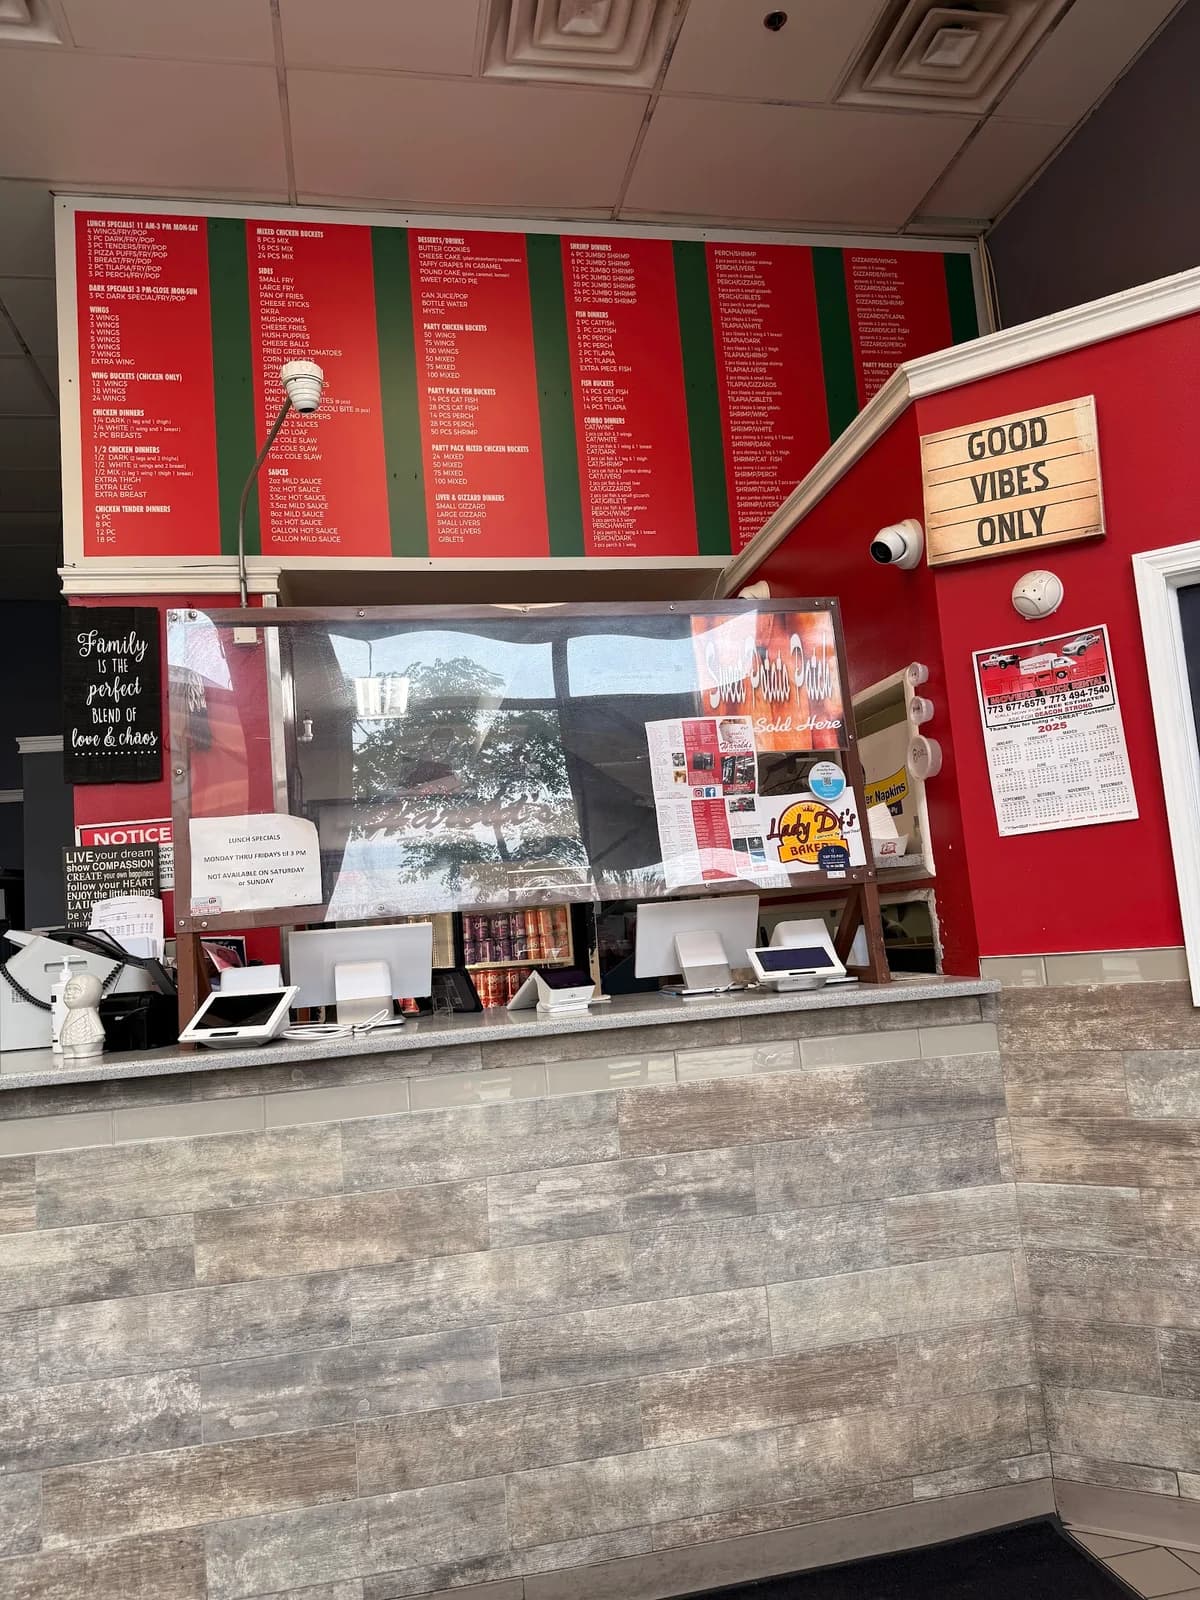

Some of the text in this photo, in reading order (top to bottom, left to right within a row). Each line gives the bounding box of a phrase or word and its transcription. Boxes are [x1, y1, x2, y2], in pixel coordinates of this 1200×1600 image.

[107, 221, 134, 229] SPECIALS!
[107, 285, 134, 294] SPECIALS!
[142, 286, 172, 295] PM-CLOSE
[968, 417, 1047, 459] GOOD
[970, 461, 1049, 503] VIBES
[978, 506, 1046, 546] ONLY
[77, 630, 148, 662] Family
[98, 658, 128, 673] IS THE
[705, 631, 832, 709] Sweet Potato Patch
[86, 676, 141, 705] perfect
[1006, 698, 1045, 711] 677-6579
[1069, 685, 1110, 699] 494-7540
[1064, 695, 1104, 705] ESTIMATES
[92, 707, 136, 723] BLEND OF
[1035, 708, 1063, 717] DEACON
[1065, 703, 1093, 712] STRONG
[756, 715, 842, 732] Sold Here
[1038, 722, 1067, 733] 2025
[72, 726, 158, 747] love & chaos
[875, 782, 905, 801] Napkins
[766, 813, 810, 844] Lady
[814, 808, 856, 834] Di's
[94, 828, 171, 845] NOTICE
[66, 851, 94, 863] LIVE
[121, 850, 153, 858] dream
[790, 843, 833, 856] BAKE
[204, 854, 233, 862] MONDAY
[67, 860, 153, 872] show COMPASSION
[67, 872, 102, 881] CREATE
[129, 870, 153, 879] happiness
[67, 878, 154, 891] follow your HEART
[67, 892, 92, 900] ENJOY
[68, 911, 79, 920] be
